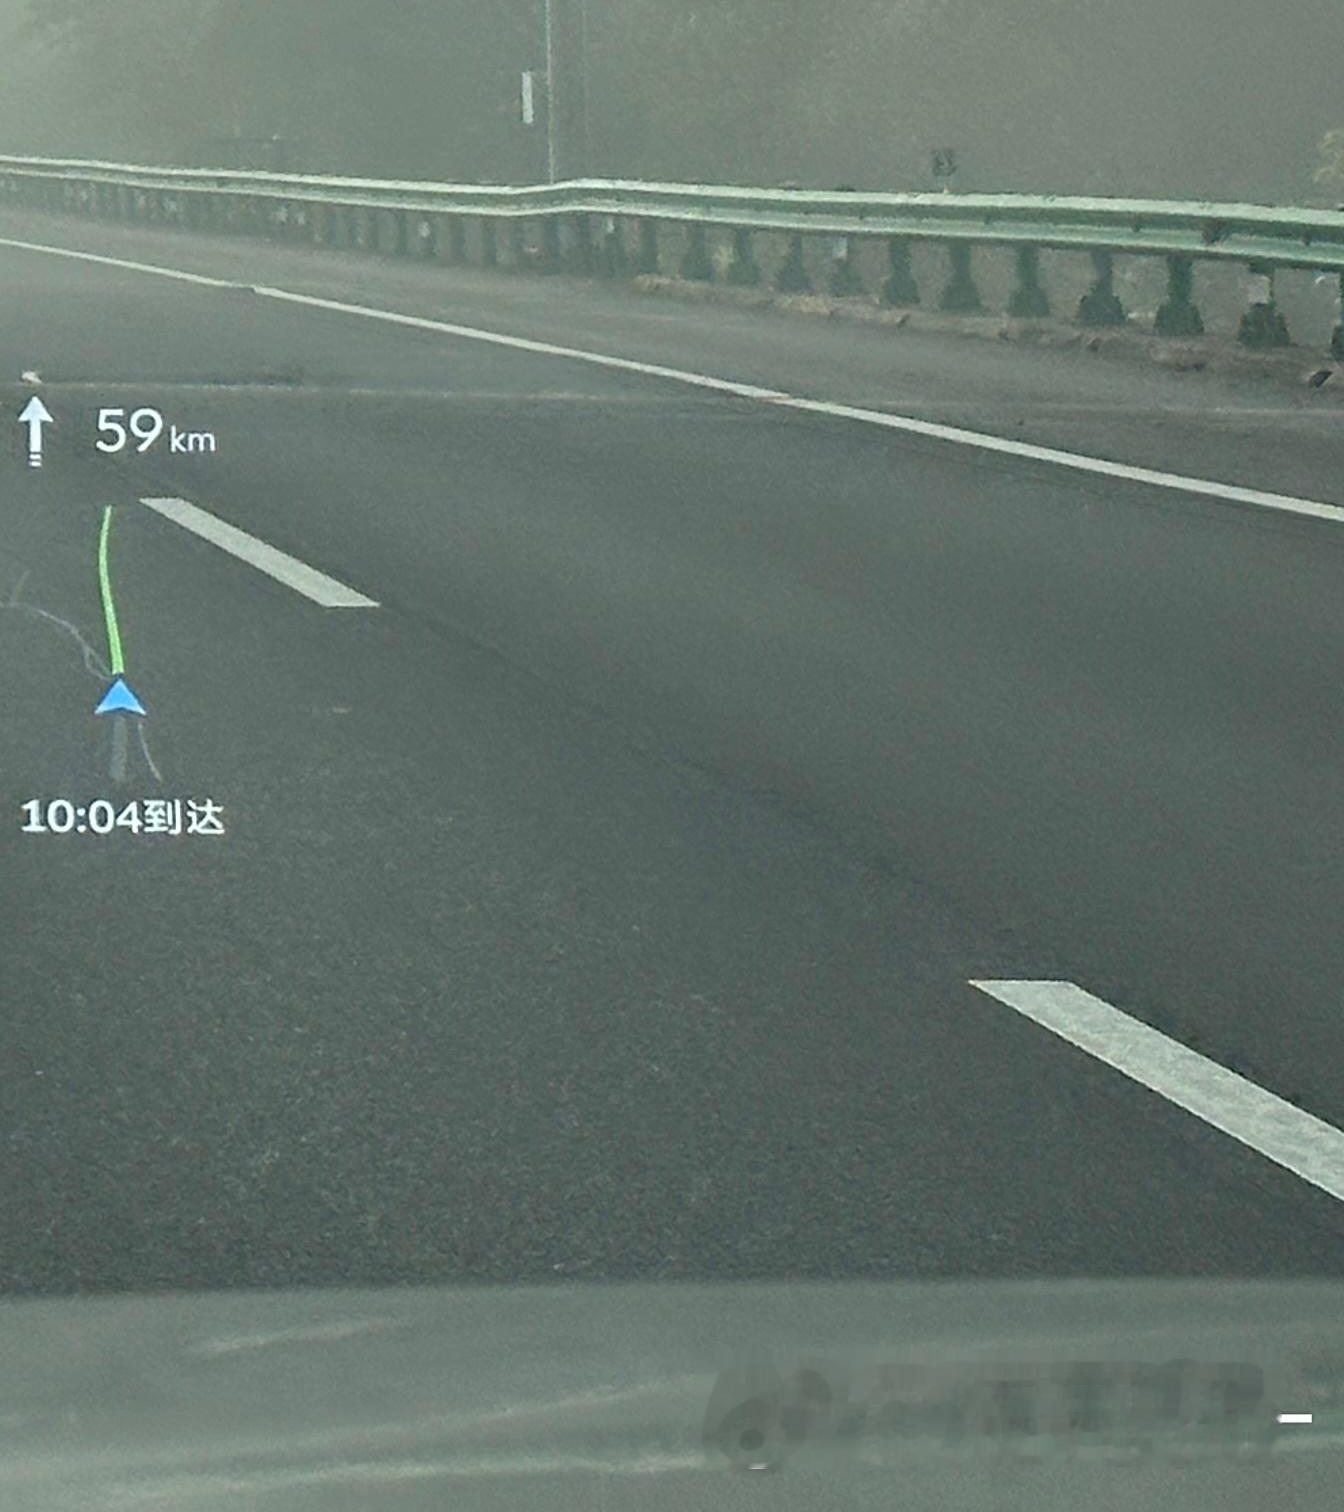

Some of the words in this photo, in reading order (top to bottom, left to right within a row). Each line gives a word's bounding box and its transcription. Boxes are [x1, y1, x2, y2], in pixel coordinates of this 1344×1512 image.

[96, 407, 163, 453] 59
[170, 425, 216, 453] km
[20, 798, 225, 835] 10:04到达
